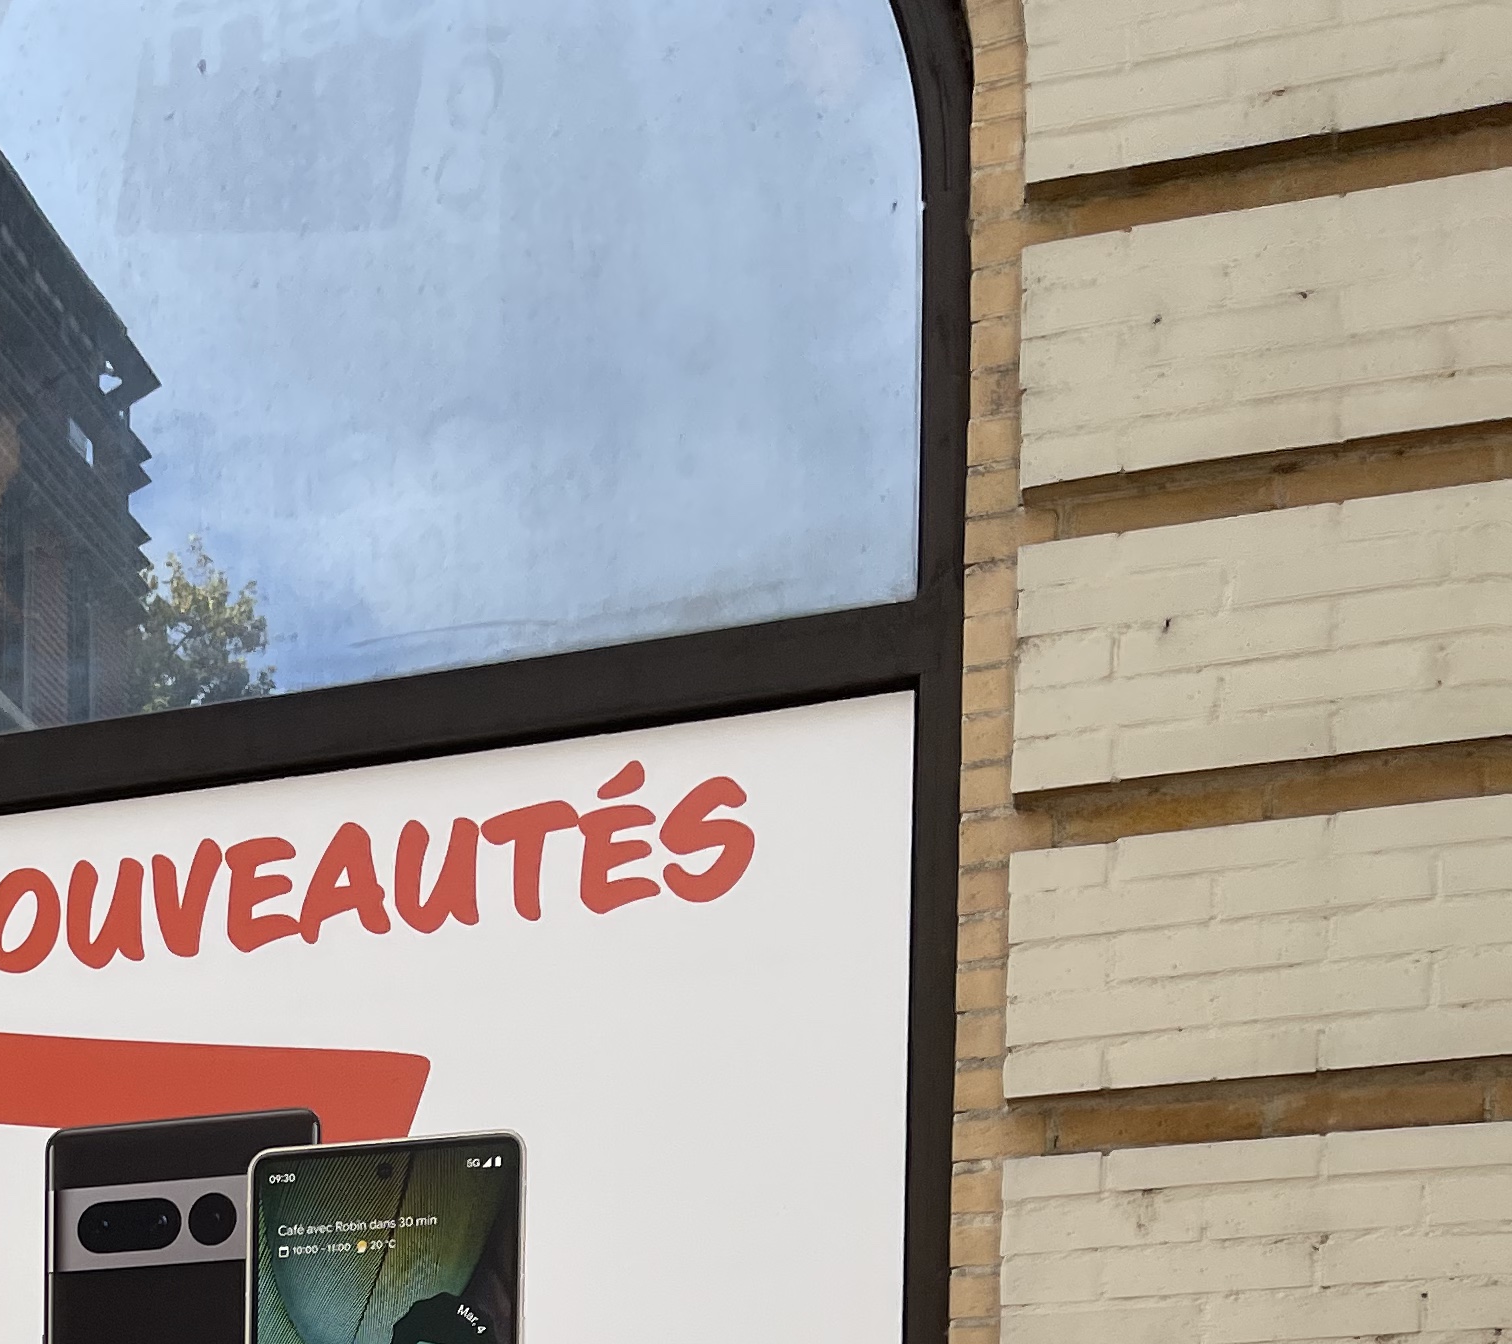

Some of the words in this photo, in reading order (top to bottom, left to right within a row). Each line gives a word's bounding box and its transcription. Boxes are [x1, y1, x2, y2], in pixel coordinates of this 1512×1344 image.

[269, 1172, 296, 1185] 09:30
[277, 1223, 305, 1237] Café
[306, 1225, 334, 1235] avec
[335, 1220, 367, 1232] Robin
[369, 1218, 396, 1230] dans
[398, 1216, 414, 1228] 30
[416, 1214, 438, 1227] min
[292, 1245, 319, 1255] 10:00
